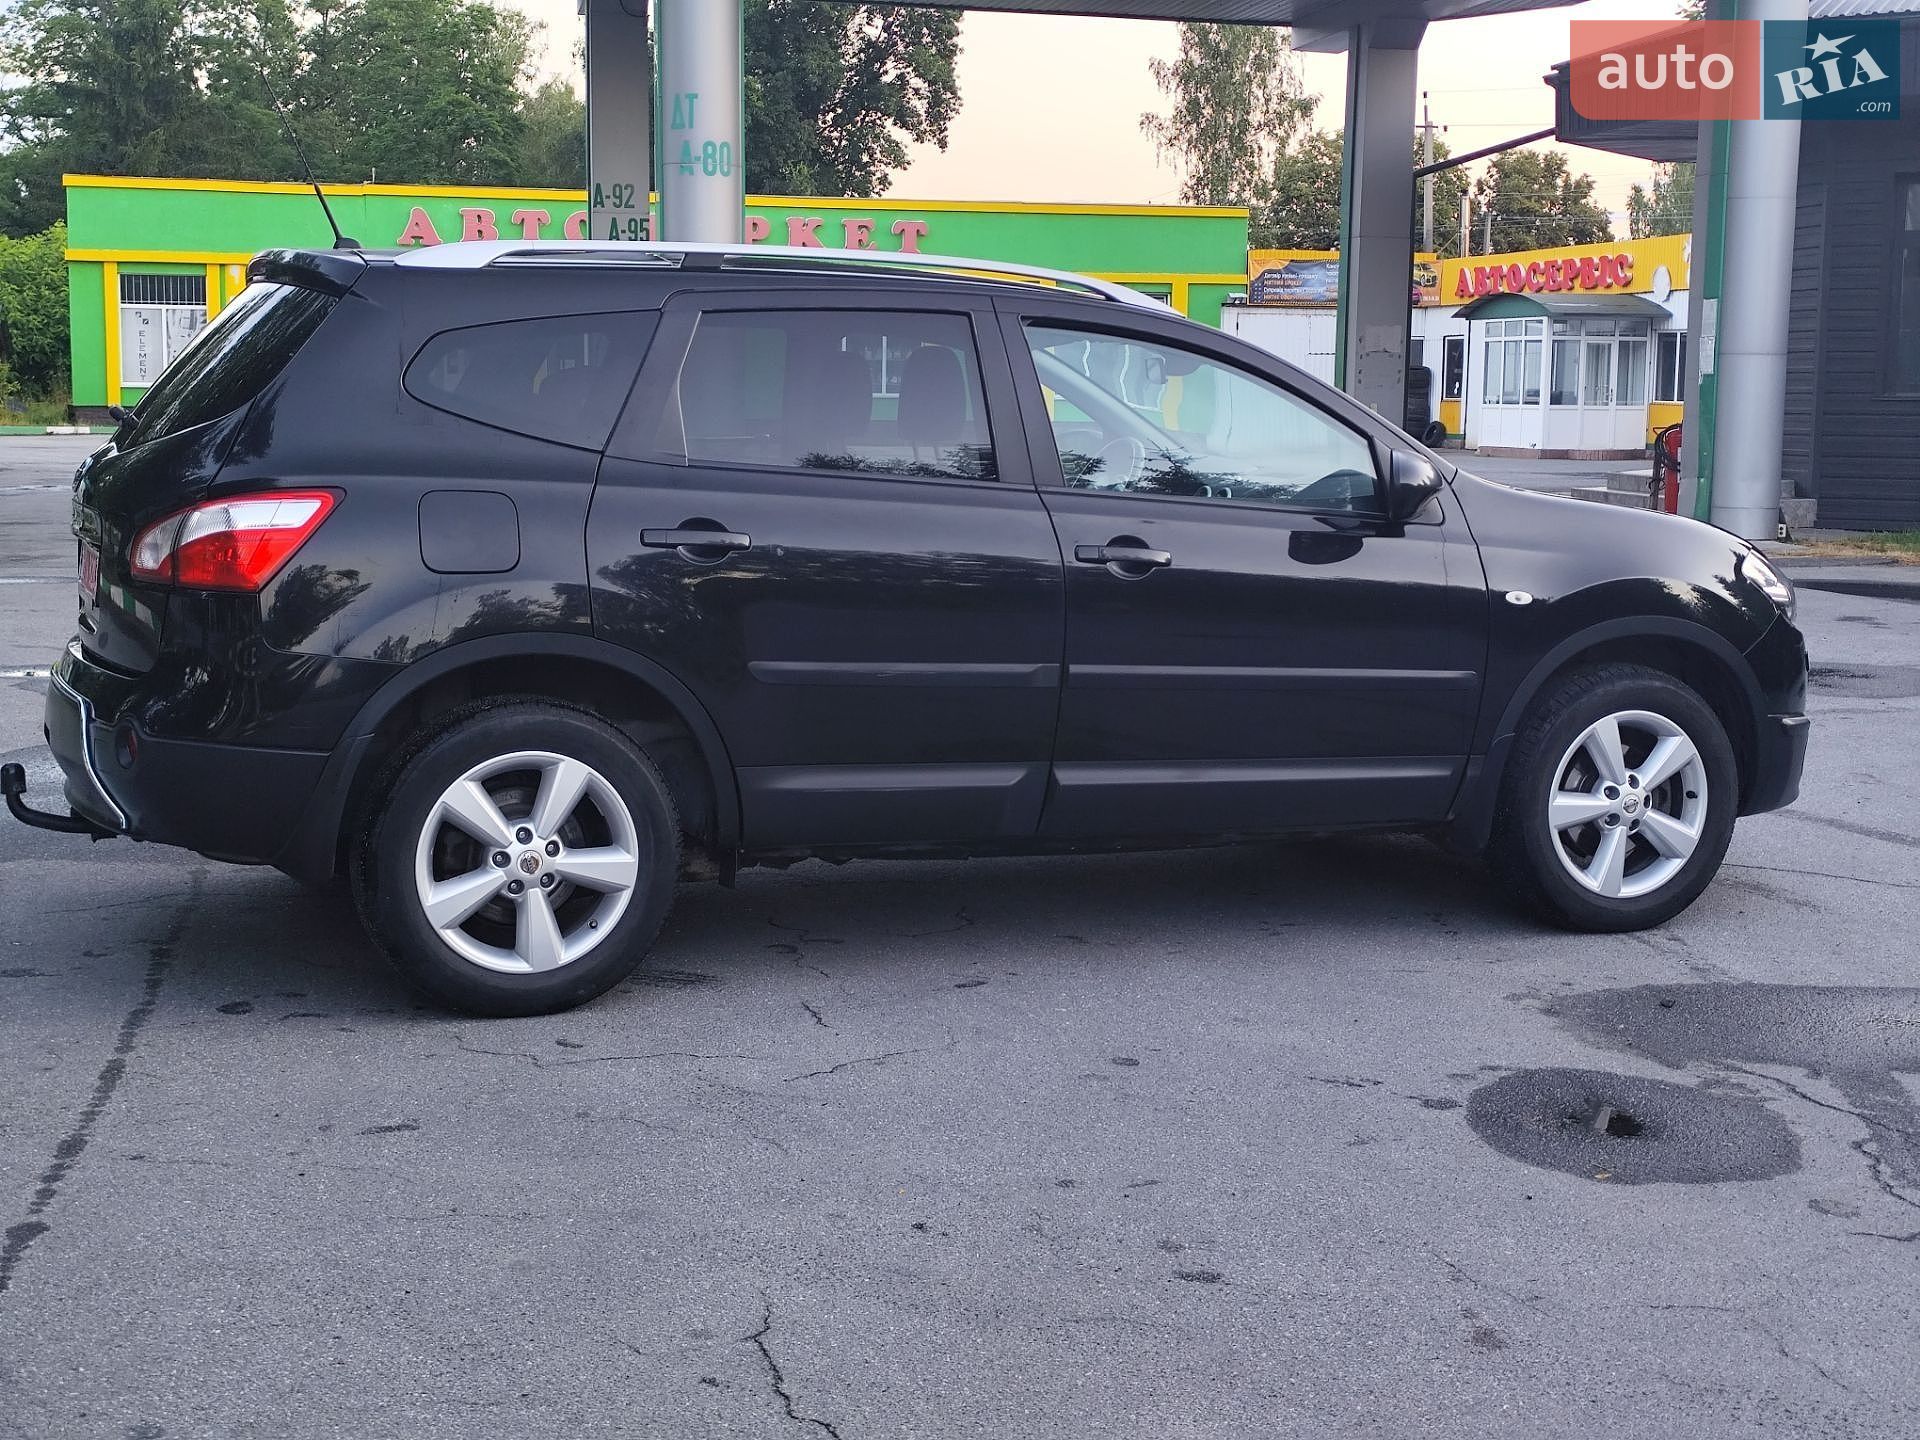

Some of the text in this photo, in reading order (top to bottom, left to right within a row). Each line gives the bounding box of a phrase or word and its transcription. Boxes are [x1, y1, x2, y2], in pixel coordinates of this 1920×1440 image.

[679, 140, 732, 177] А-80
[593, 183, 635, 209] А-92
[609, 217, 650, 241] А-95
[1455, 253, 1634, 298] АВТОСЕРВІС
[139, 330, 147, 381] ELEMENT
